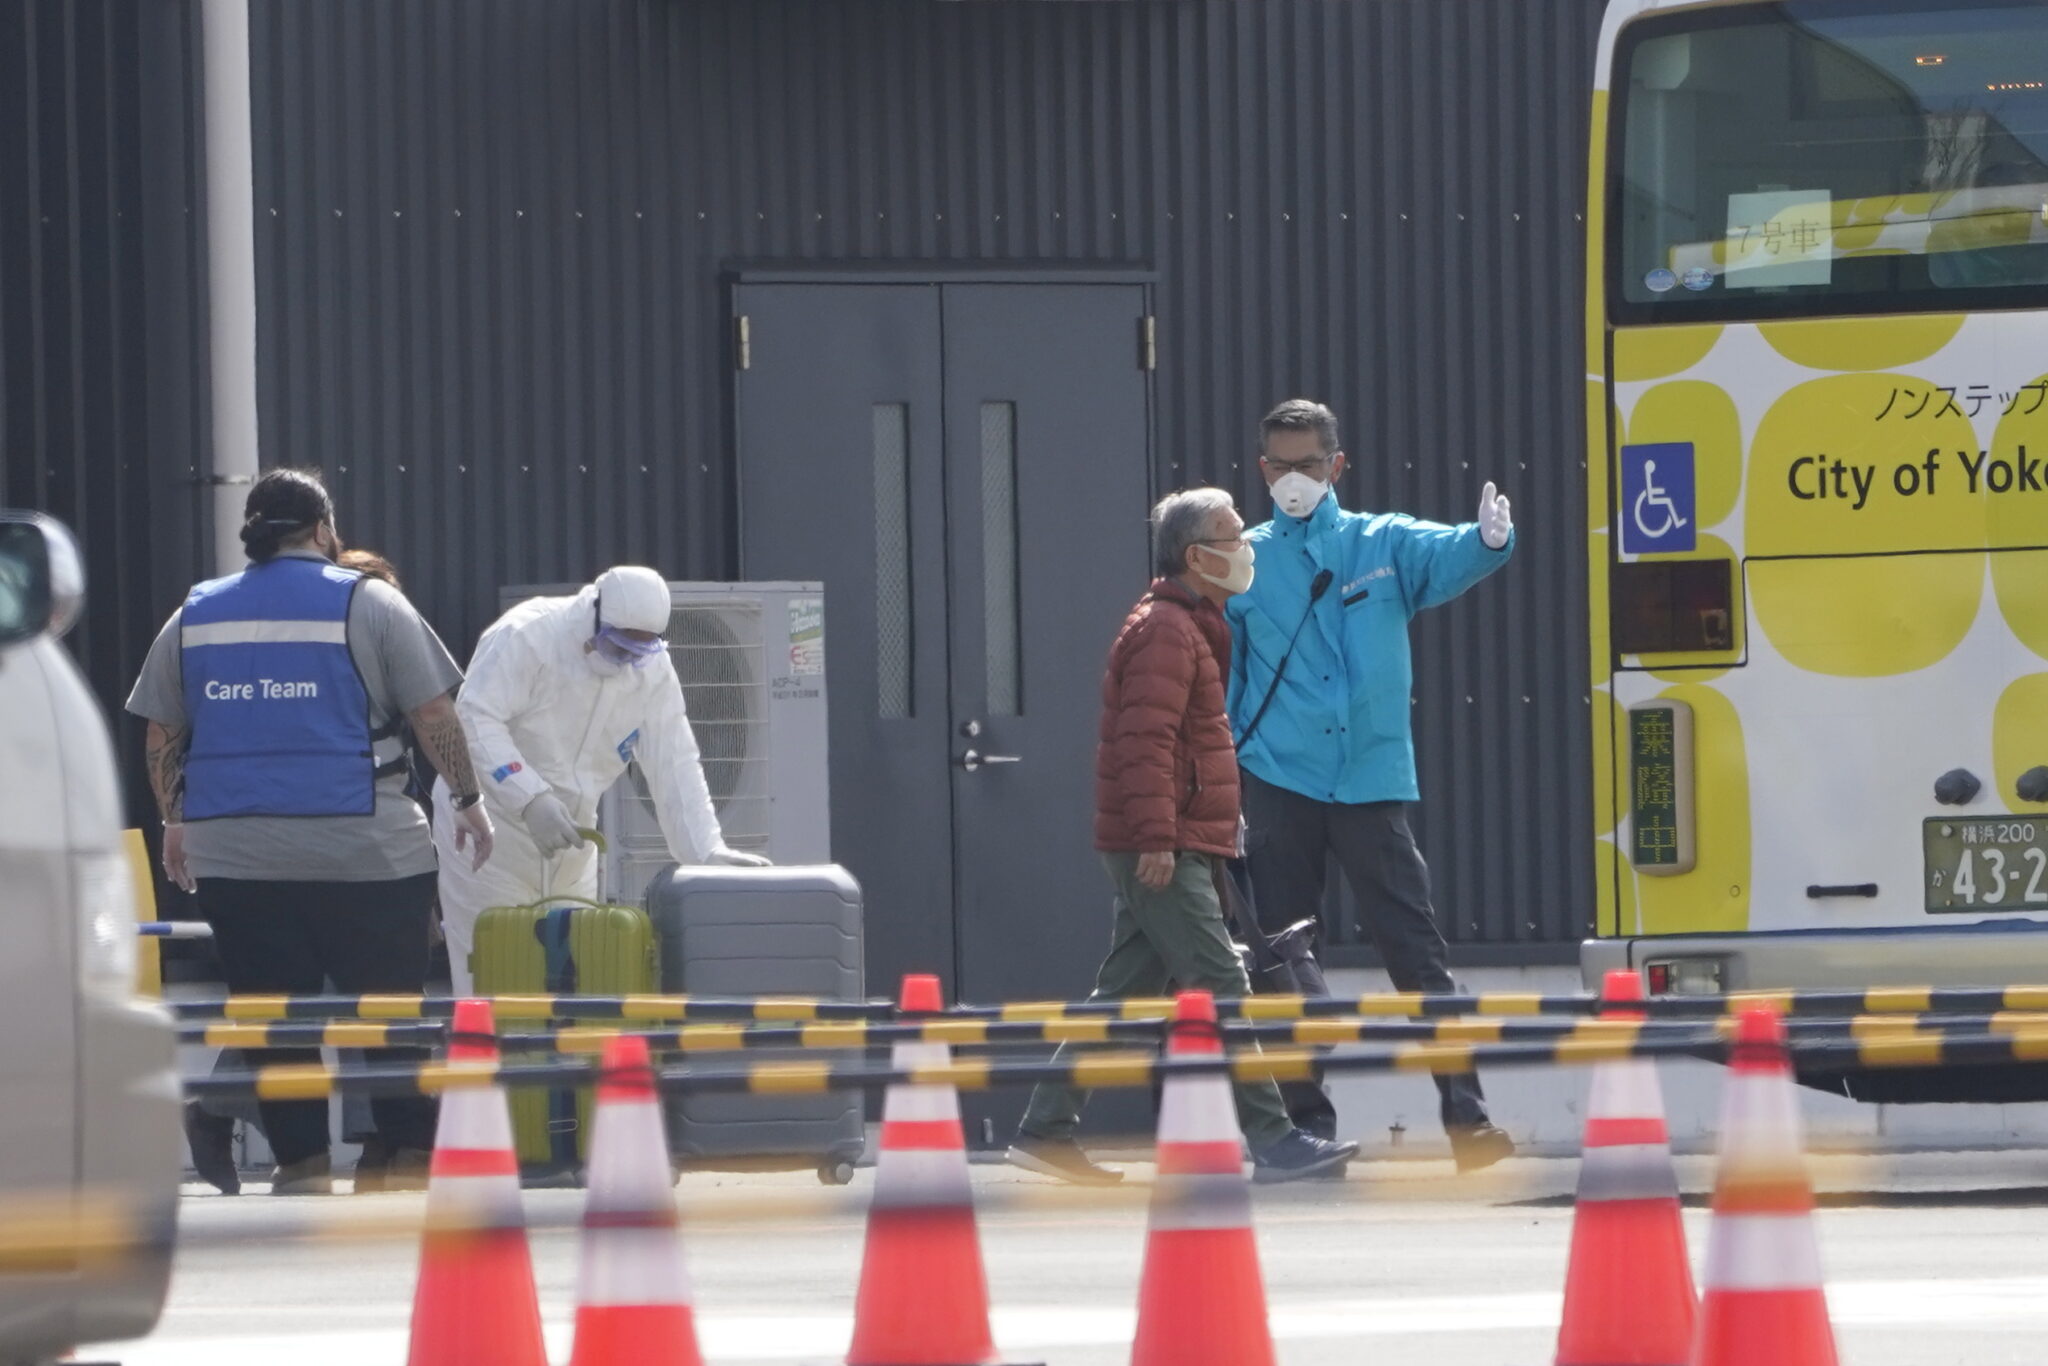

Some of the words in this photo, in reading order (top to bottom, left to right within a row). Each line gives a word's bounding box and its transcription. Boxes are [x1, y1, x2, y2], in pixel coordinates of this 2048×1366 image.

[1736, 219, 1821, 255] 7号車
[1788, 454, 1876, 511] City
[1893, 448, 1940, 497] of
[1956, 445, 2048, 494] Yok
[204, 680, 254, 700] Care
[258, 679, 318, 699] Team
